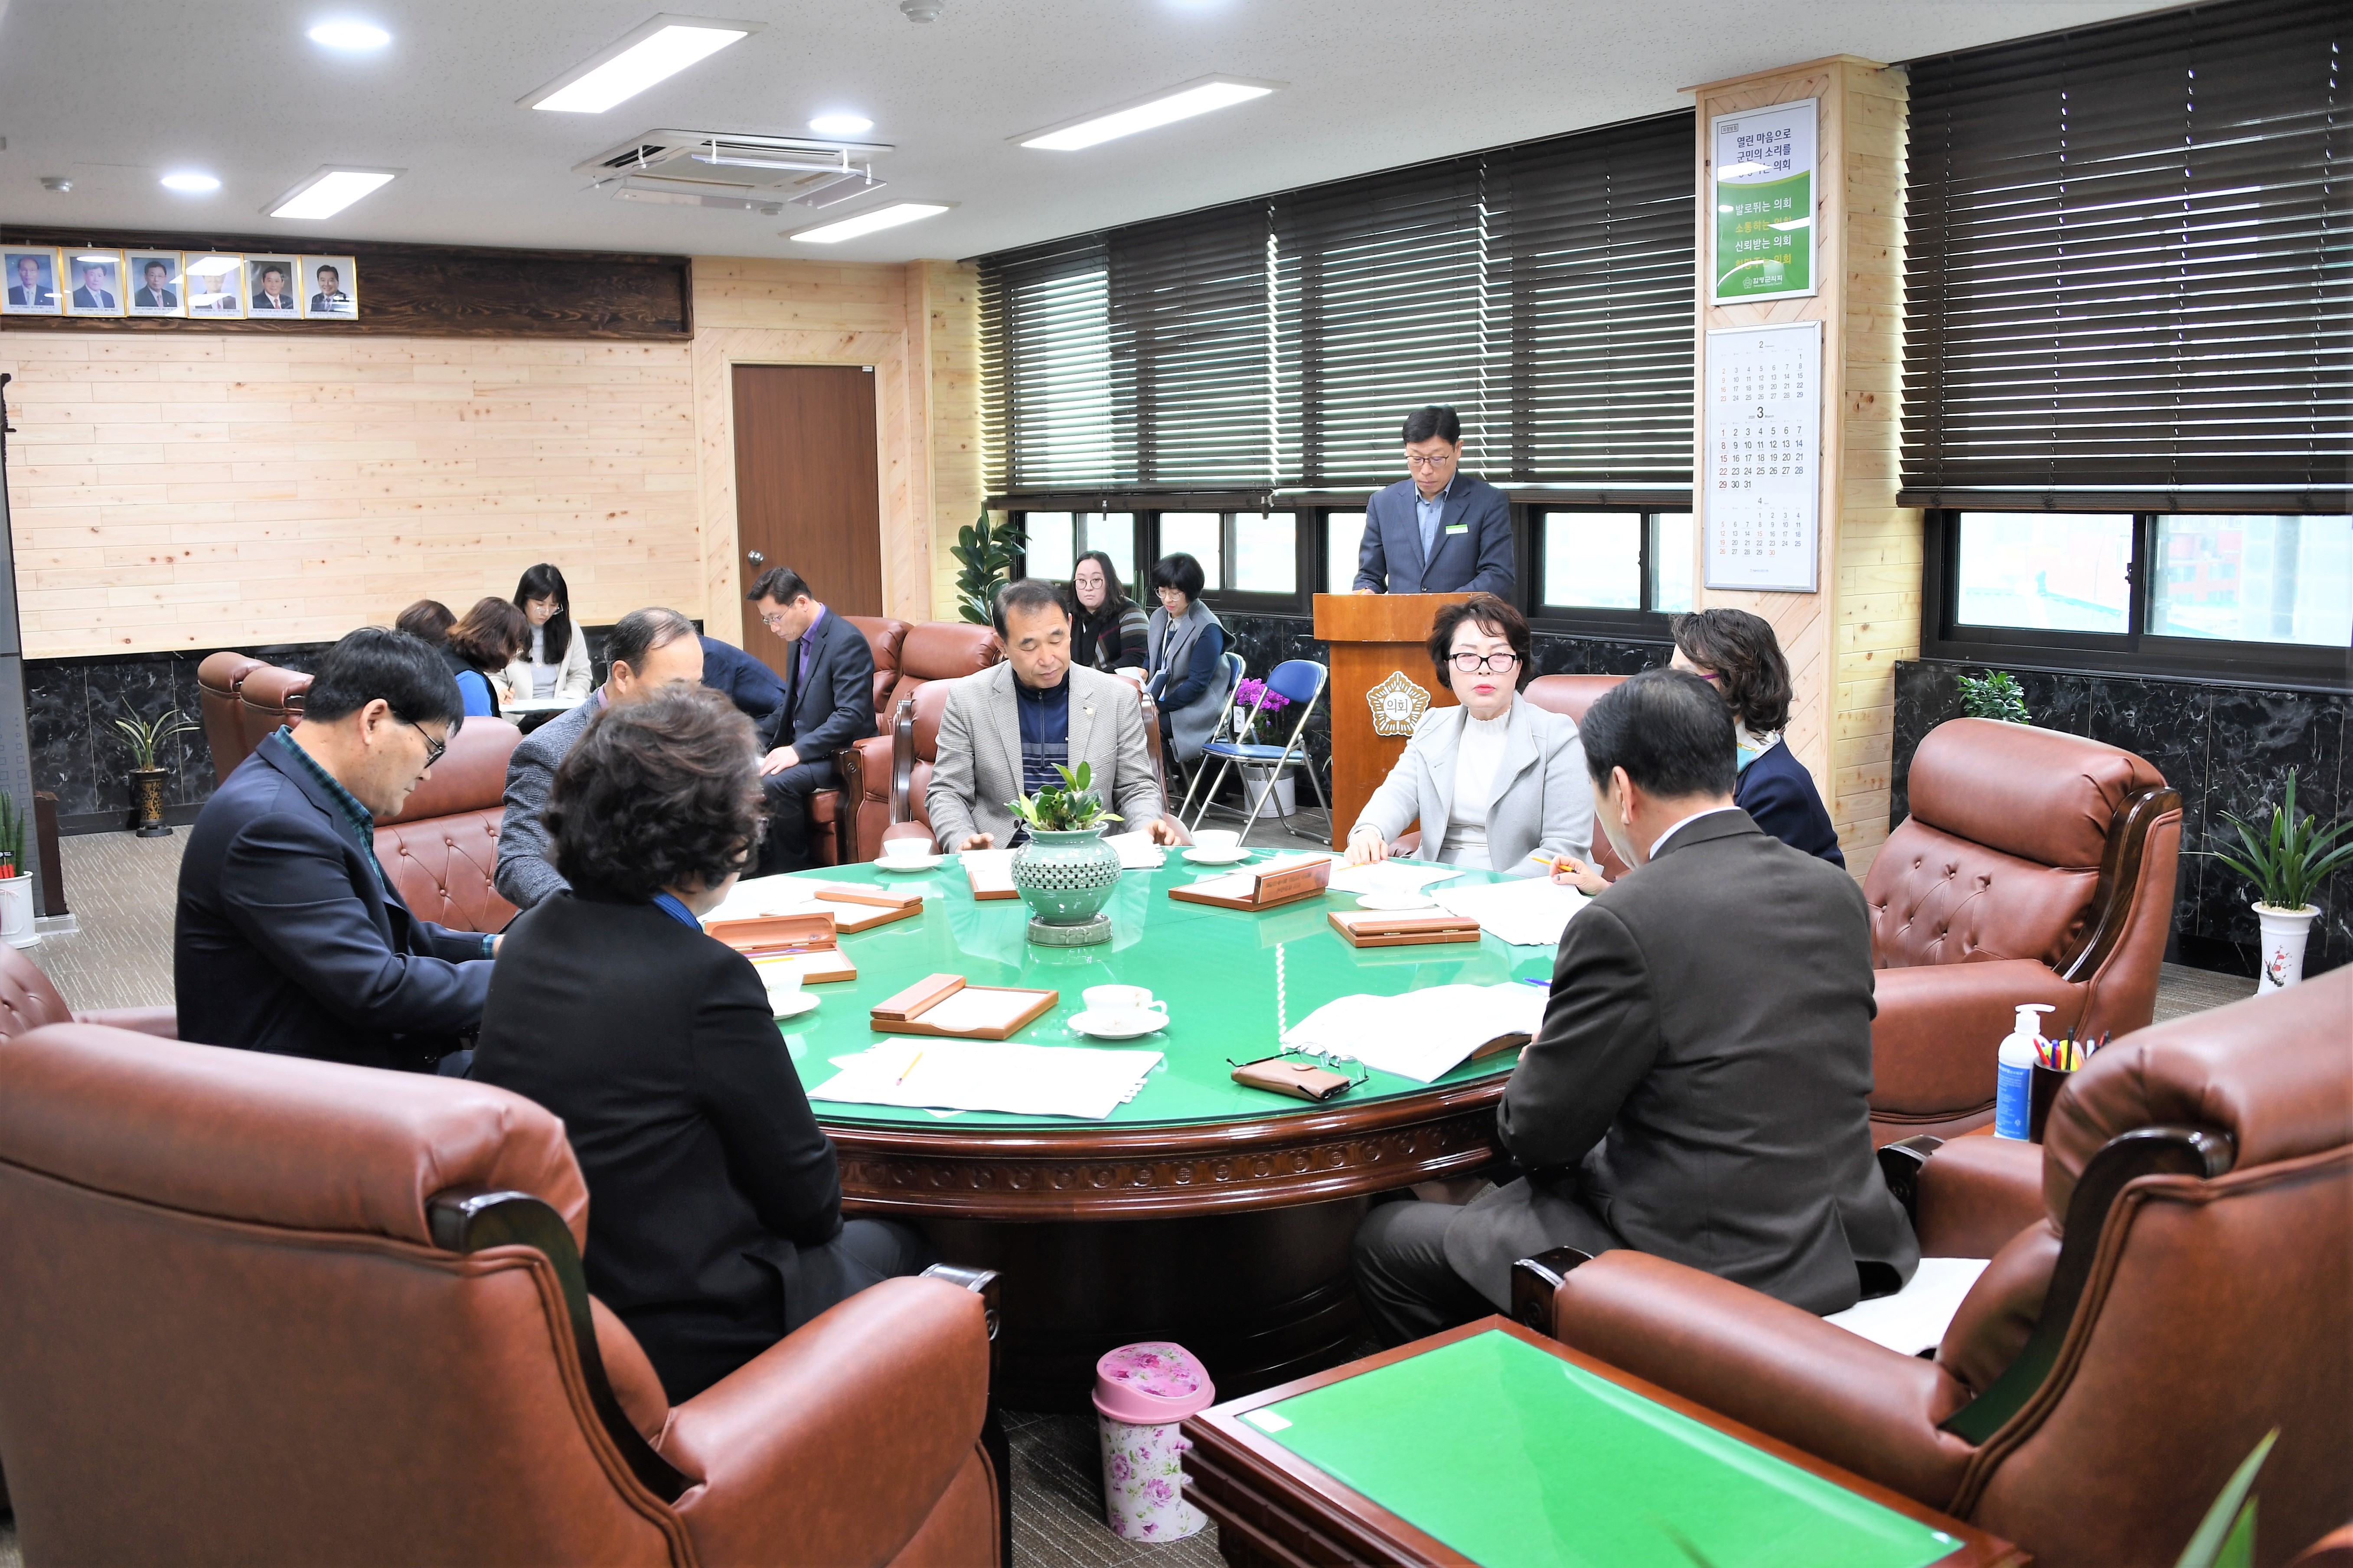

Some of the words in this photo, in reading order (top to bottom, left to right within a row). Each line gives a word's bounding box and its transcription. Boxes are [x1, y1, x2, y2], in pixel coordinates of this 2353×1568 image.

[1737, 134, 1754, 148] 열린
[1756, 128, 1791, 144] 마음으로
[1737, 148, 1762, 163] 군민의
[1765, 143, 1791, 157] 소리를
[1773, 159, 1791, 171] 의회
[1736, 201, 1770, 216] 발로뛰는
[1774, 197, 1791, 210] 의회
[1736, 220, 1770, 233] 소통하는
[1736, 238, 1770, 252] 신뢰받는
[1774, 235, 1791, 247] 의회
[1774, 254, 1791, 265] 의회
[1757, 407, 1764, 418] 3
[1387, 699, 1407, 713] 의회
